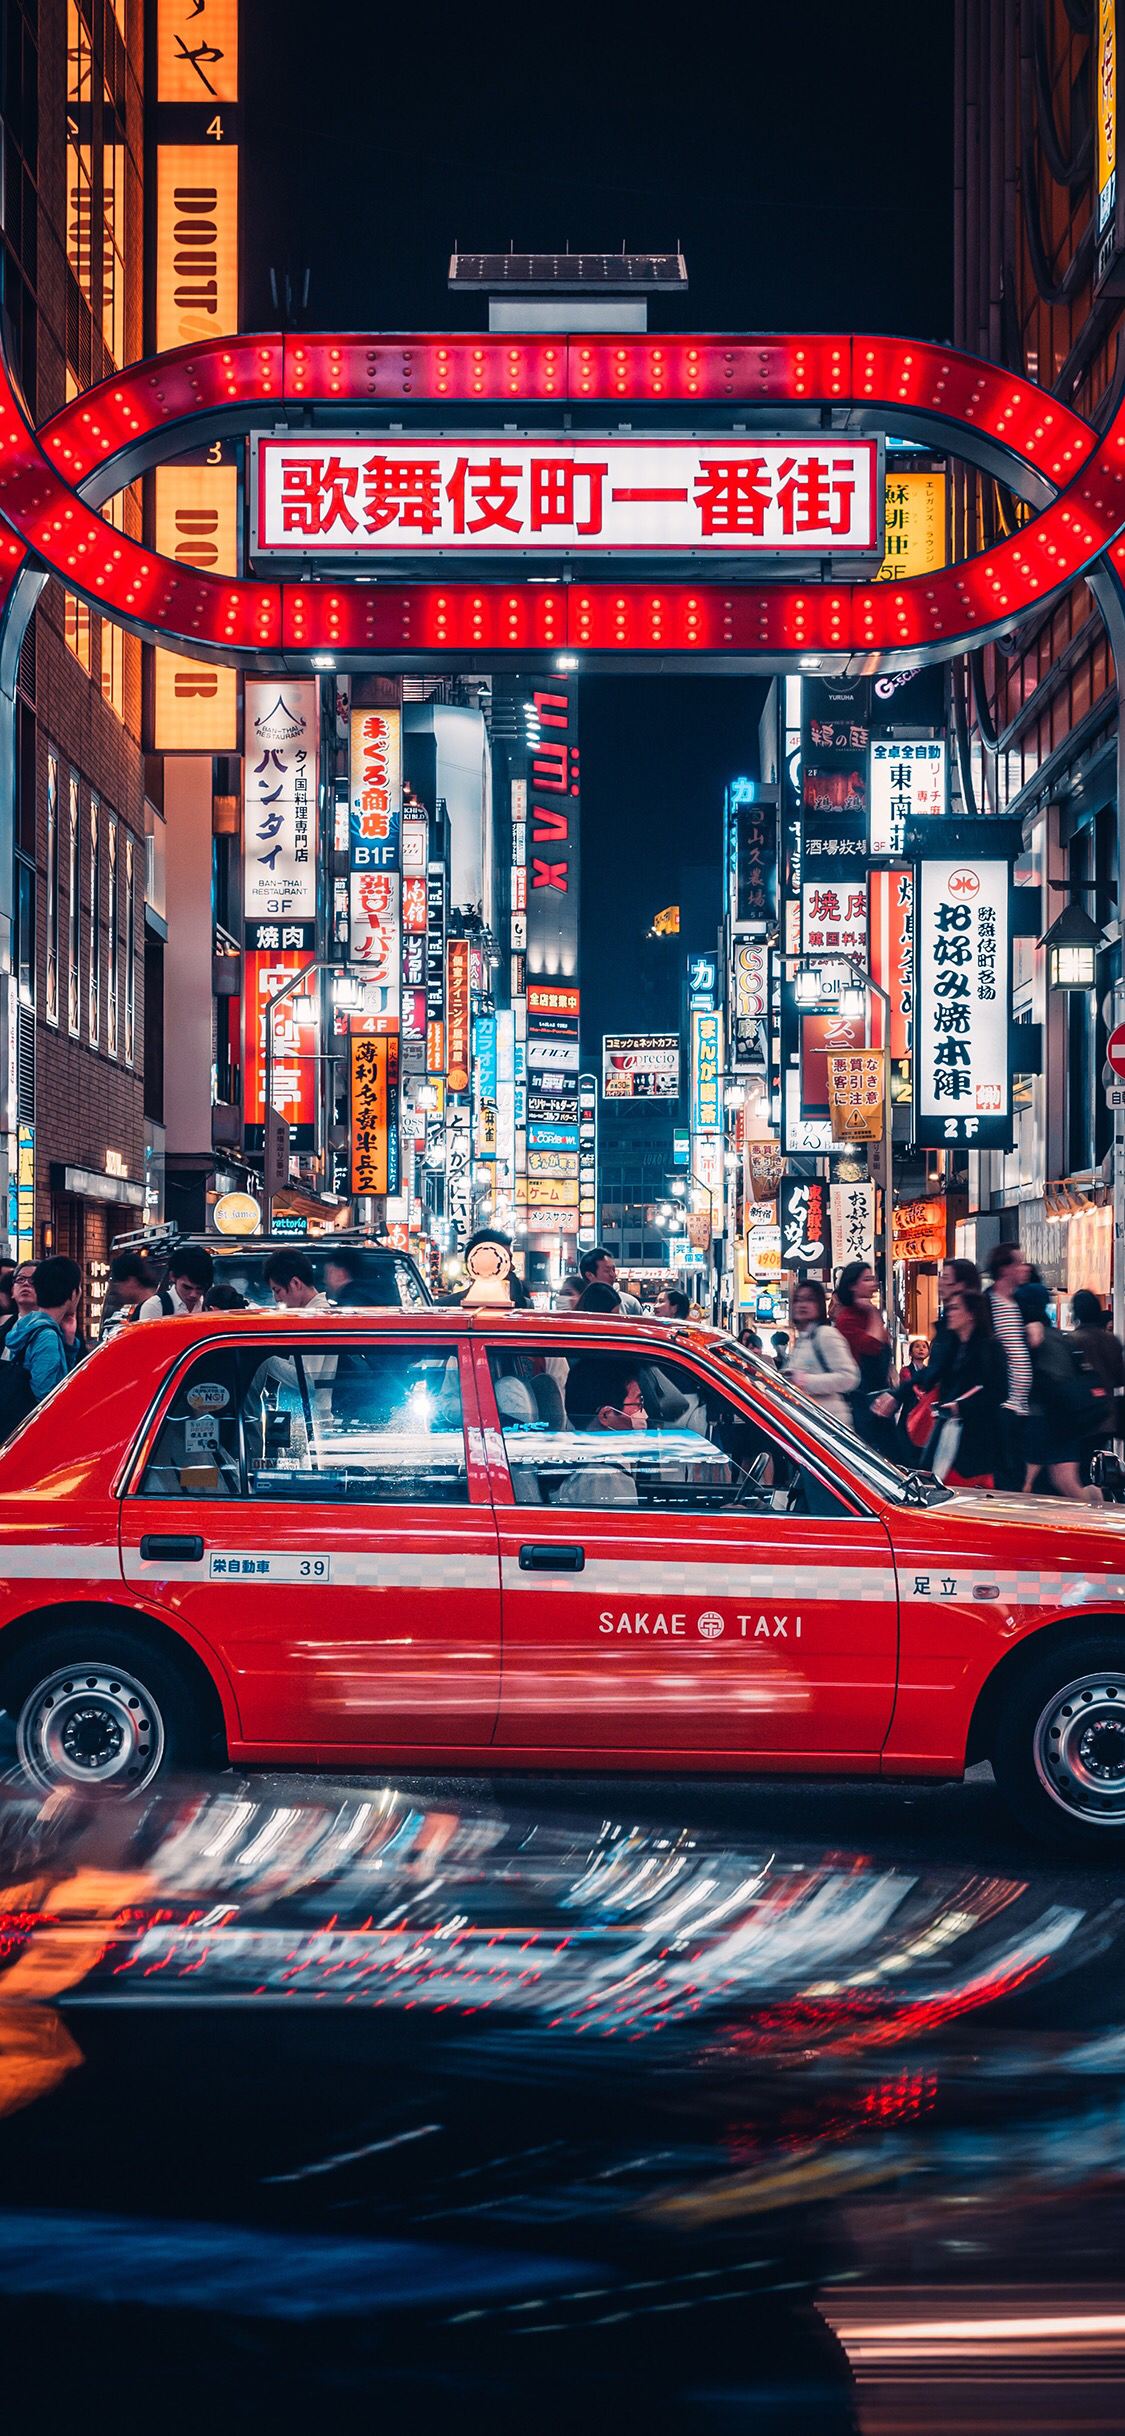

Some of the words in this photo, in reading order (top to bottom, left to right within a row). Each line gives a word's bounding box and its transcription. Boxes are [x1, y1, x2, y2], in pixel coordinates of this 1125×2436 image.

[281, 455, 857, 537] 歌舞伎町一番街
[880, 565, 907, 580] 5F
[874, 745, 942, 759] 全卓全自動
[361, 716, 392, 838] まぐろ商店
[254, 748, 288, 870] バンタイ
[295, 750, 309, 863] タイ国料理専門店
[873, 841, 886, 852] 3F
[355, 846, 395, 866] B1F
[267, 900, 293, 913] 3F
[809, 890, 867, 921] 焼肉
[257, 926, 304, 949] 焼肉
[977, 906, 996, 1000] 歌舞伎町名物
[452, 956, 463, 1062] 個室ダイニング居酒屋
[529, 992, 577, 1008] 全店営業中
[933, 903, 972, 1100] お好み焼本陣
[362, 1018, 387, 1032] 4F
[480, 1019, 494, 1079] カラオケ
[606, 1038, 679, 1048] コミック&ネットカフェ
[833, 1057, 880, 1074] 悪質な
[833, 1075, 880, 1090] 客引き
[833, 1092, 880, 1107] に注意
[1112, 1091, 1125, 1105] 自
[272, 1217, 307, 1229] rattoria
[213, 1558, 270, 1574] 栄自動車
[300, 1560, 324, 1576] 39
[913, 1577, 957, 1596] 足立
[599, 1611, 687, 1637] SAKAE
[738, 1614, 802, 1638] TAXI
